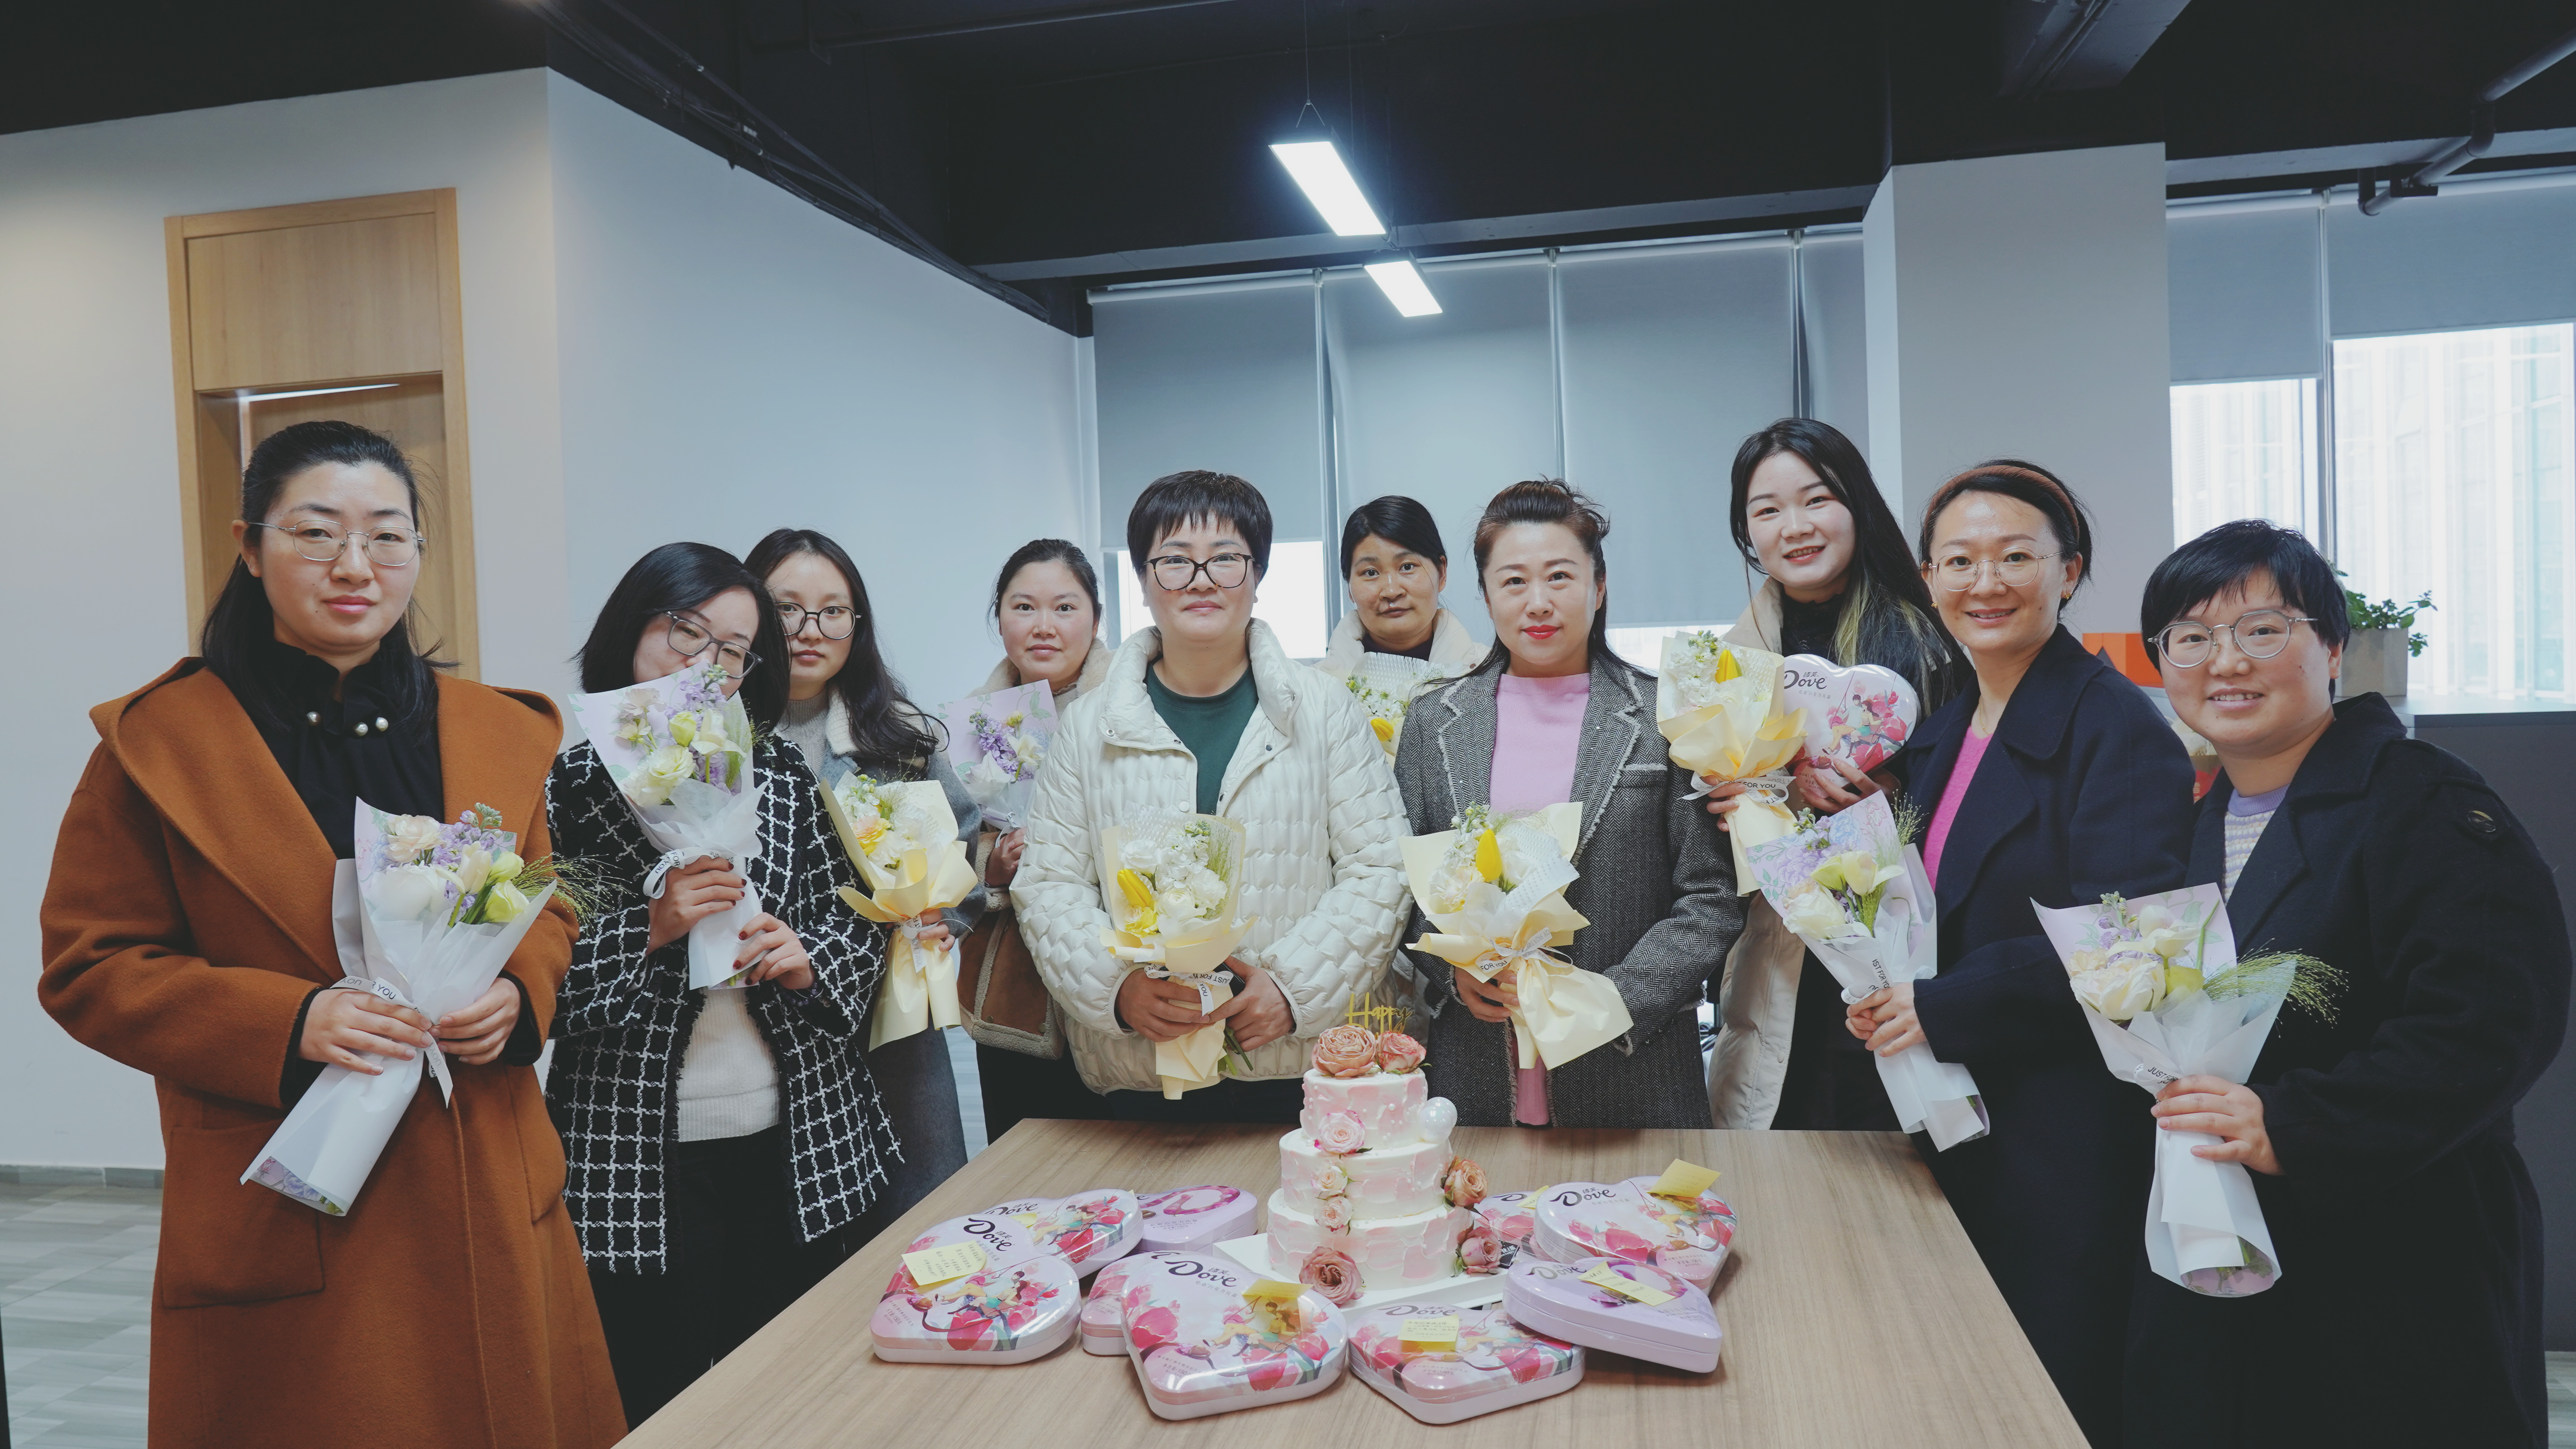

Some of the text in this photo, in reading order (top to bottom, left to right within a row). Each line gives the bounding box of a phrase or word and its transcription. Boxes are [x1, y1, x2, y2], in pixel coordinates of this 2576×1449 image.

[1784, 670, 1827, 689] Dove
[671, 852, 680, 866] FOR
[1480, 963, 1495, 971] FOR
[1877, 970, 1886, 981] FOR
[377, 984, 396, 1000] YOU
[1200, 983, 1208, 997] YOU
[1344, 992, 1413, 1034] Happy
[2148, 1067, 2167, 1078] JUST
[1549, 1189, 1616, 1206] Dove
[963, 1218, 1012, 1251] Dove
[1164, 1261, 1237, 1287] Dove
[1525, 1266, 1587, 1279] Dove
[1378, 1305, 1456, 1316] Dove
